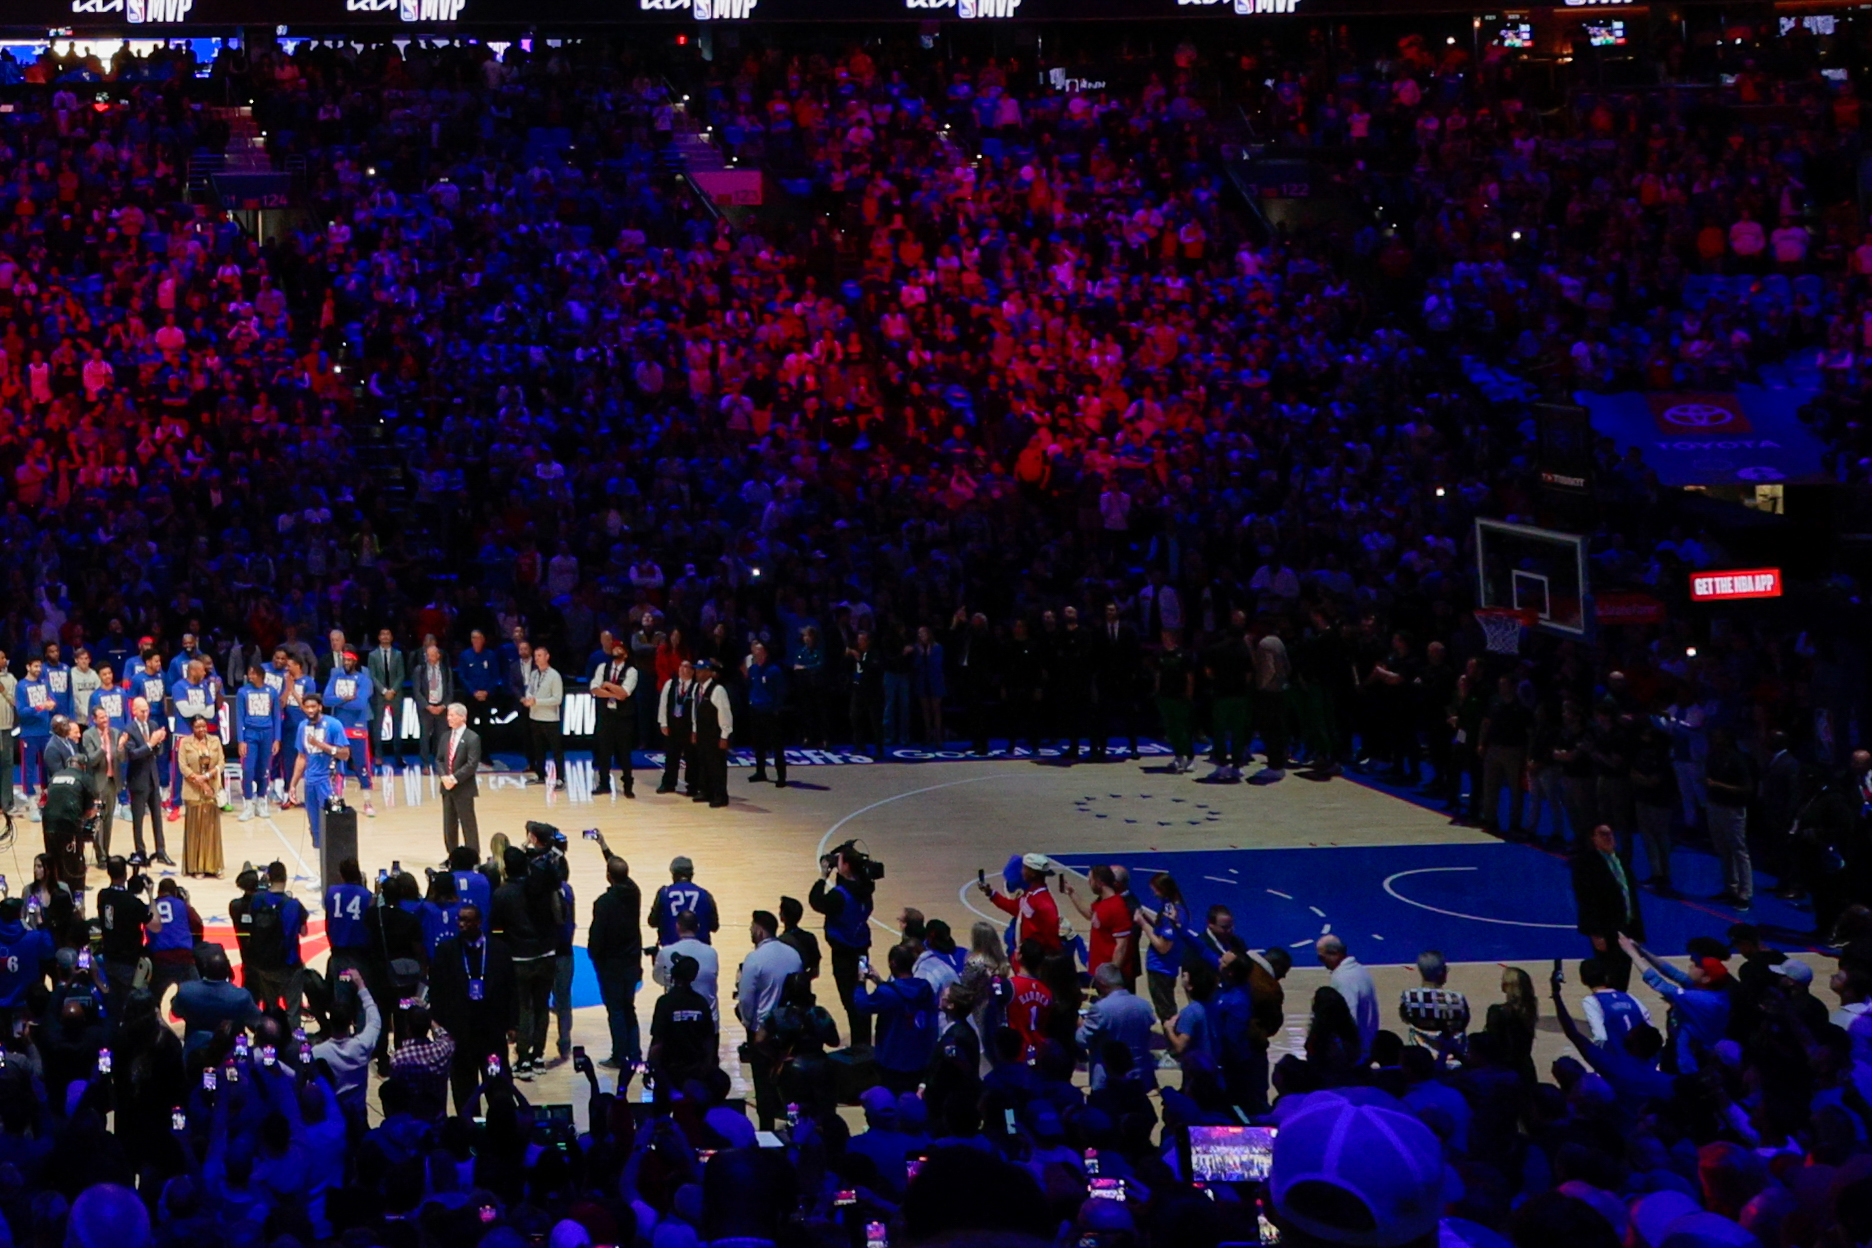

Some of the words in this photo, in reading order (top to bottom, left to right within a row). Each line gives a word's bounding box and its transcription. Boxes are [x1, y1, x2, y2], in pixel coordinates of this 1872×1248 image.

[1694, 577, 1713, 595] GET
[1714, 577, 1733, 594] THE
[1734, 575, 1754, 593] NBA
[1755, 574, 1774, 591] APP
[332, 891, 362, 921] 14
[668, 890, 700, 917] 27
[1029, 1005, 1039, 1031] 1
